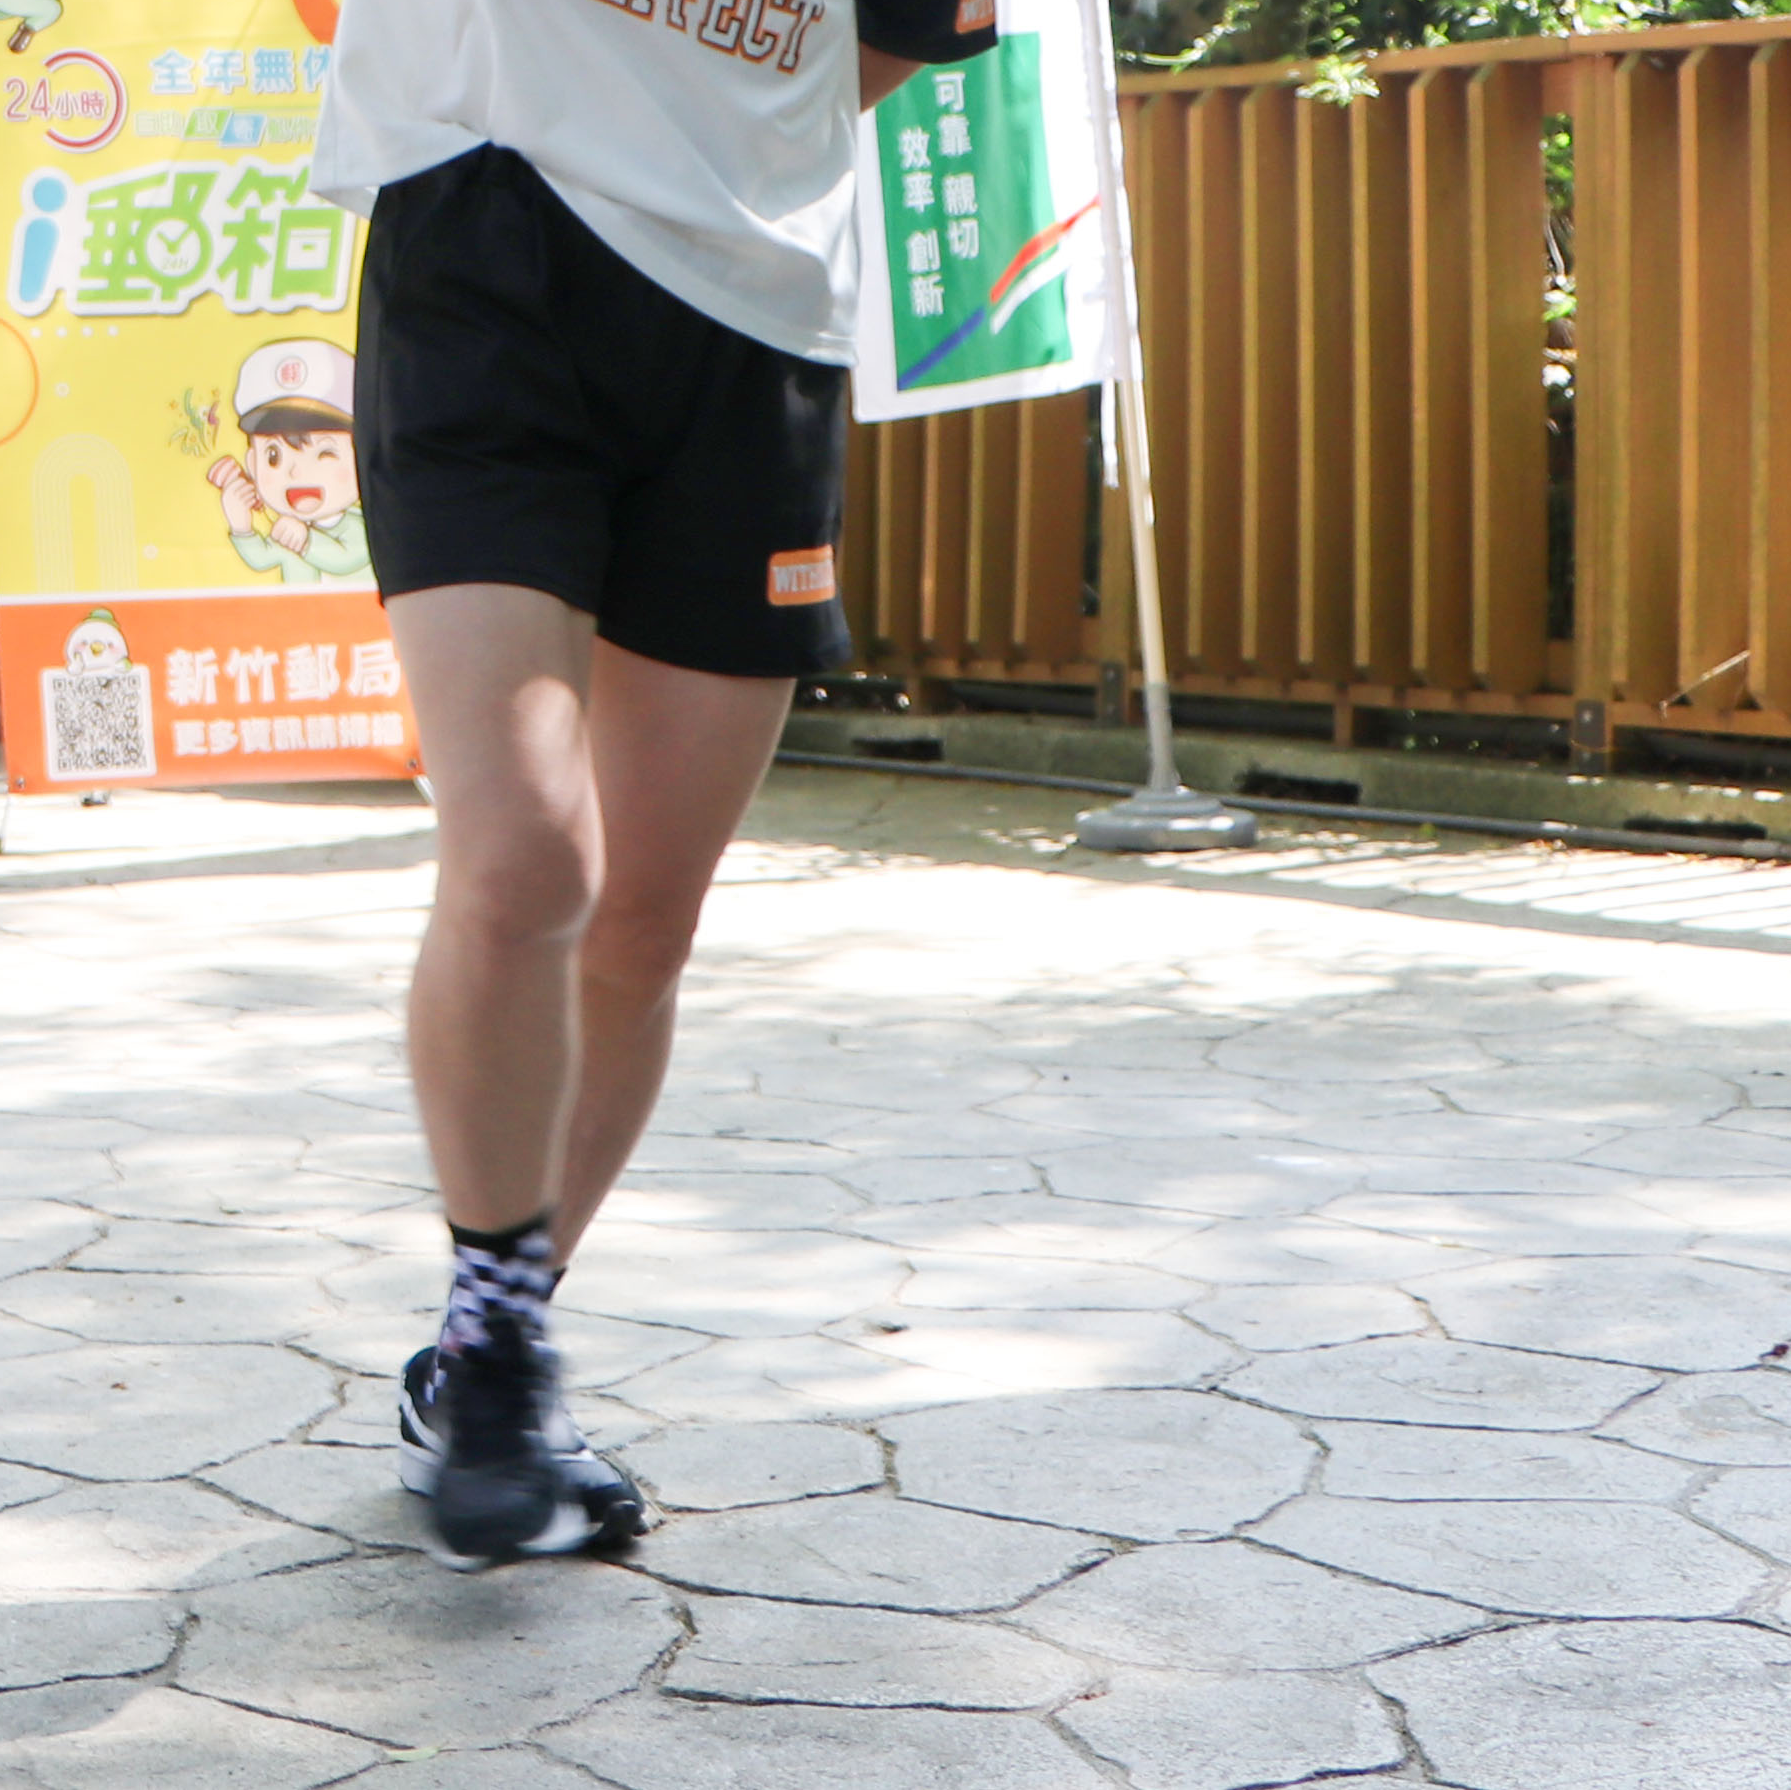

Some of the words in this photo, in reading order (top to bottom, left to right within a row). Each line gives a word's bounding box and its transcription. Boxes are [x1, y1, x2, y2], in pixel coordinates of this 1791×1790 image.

[3, 75, 106, 123] 24小時
[932, 71, 972, 156] 可靠
[898, 126, 935, 213] 效率
[941, 173, 979, 259] 親切
[906, 228, 945, 318] 創新
[165, 638, 402, 706] 新竹郵局
